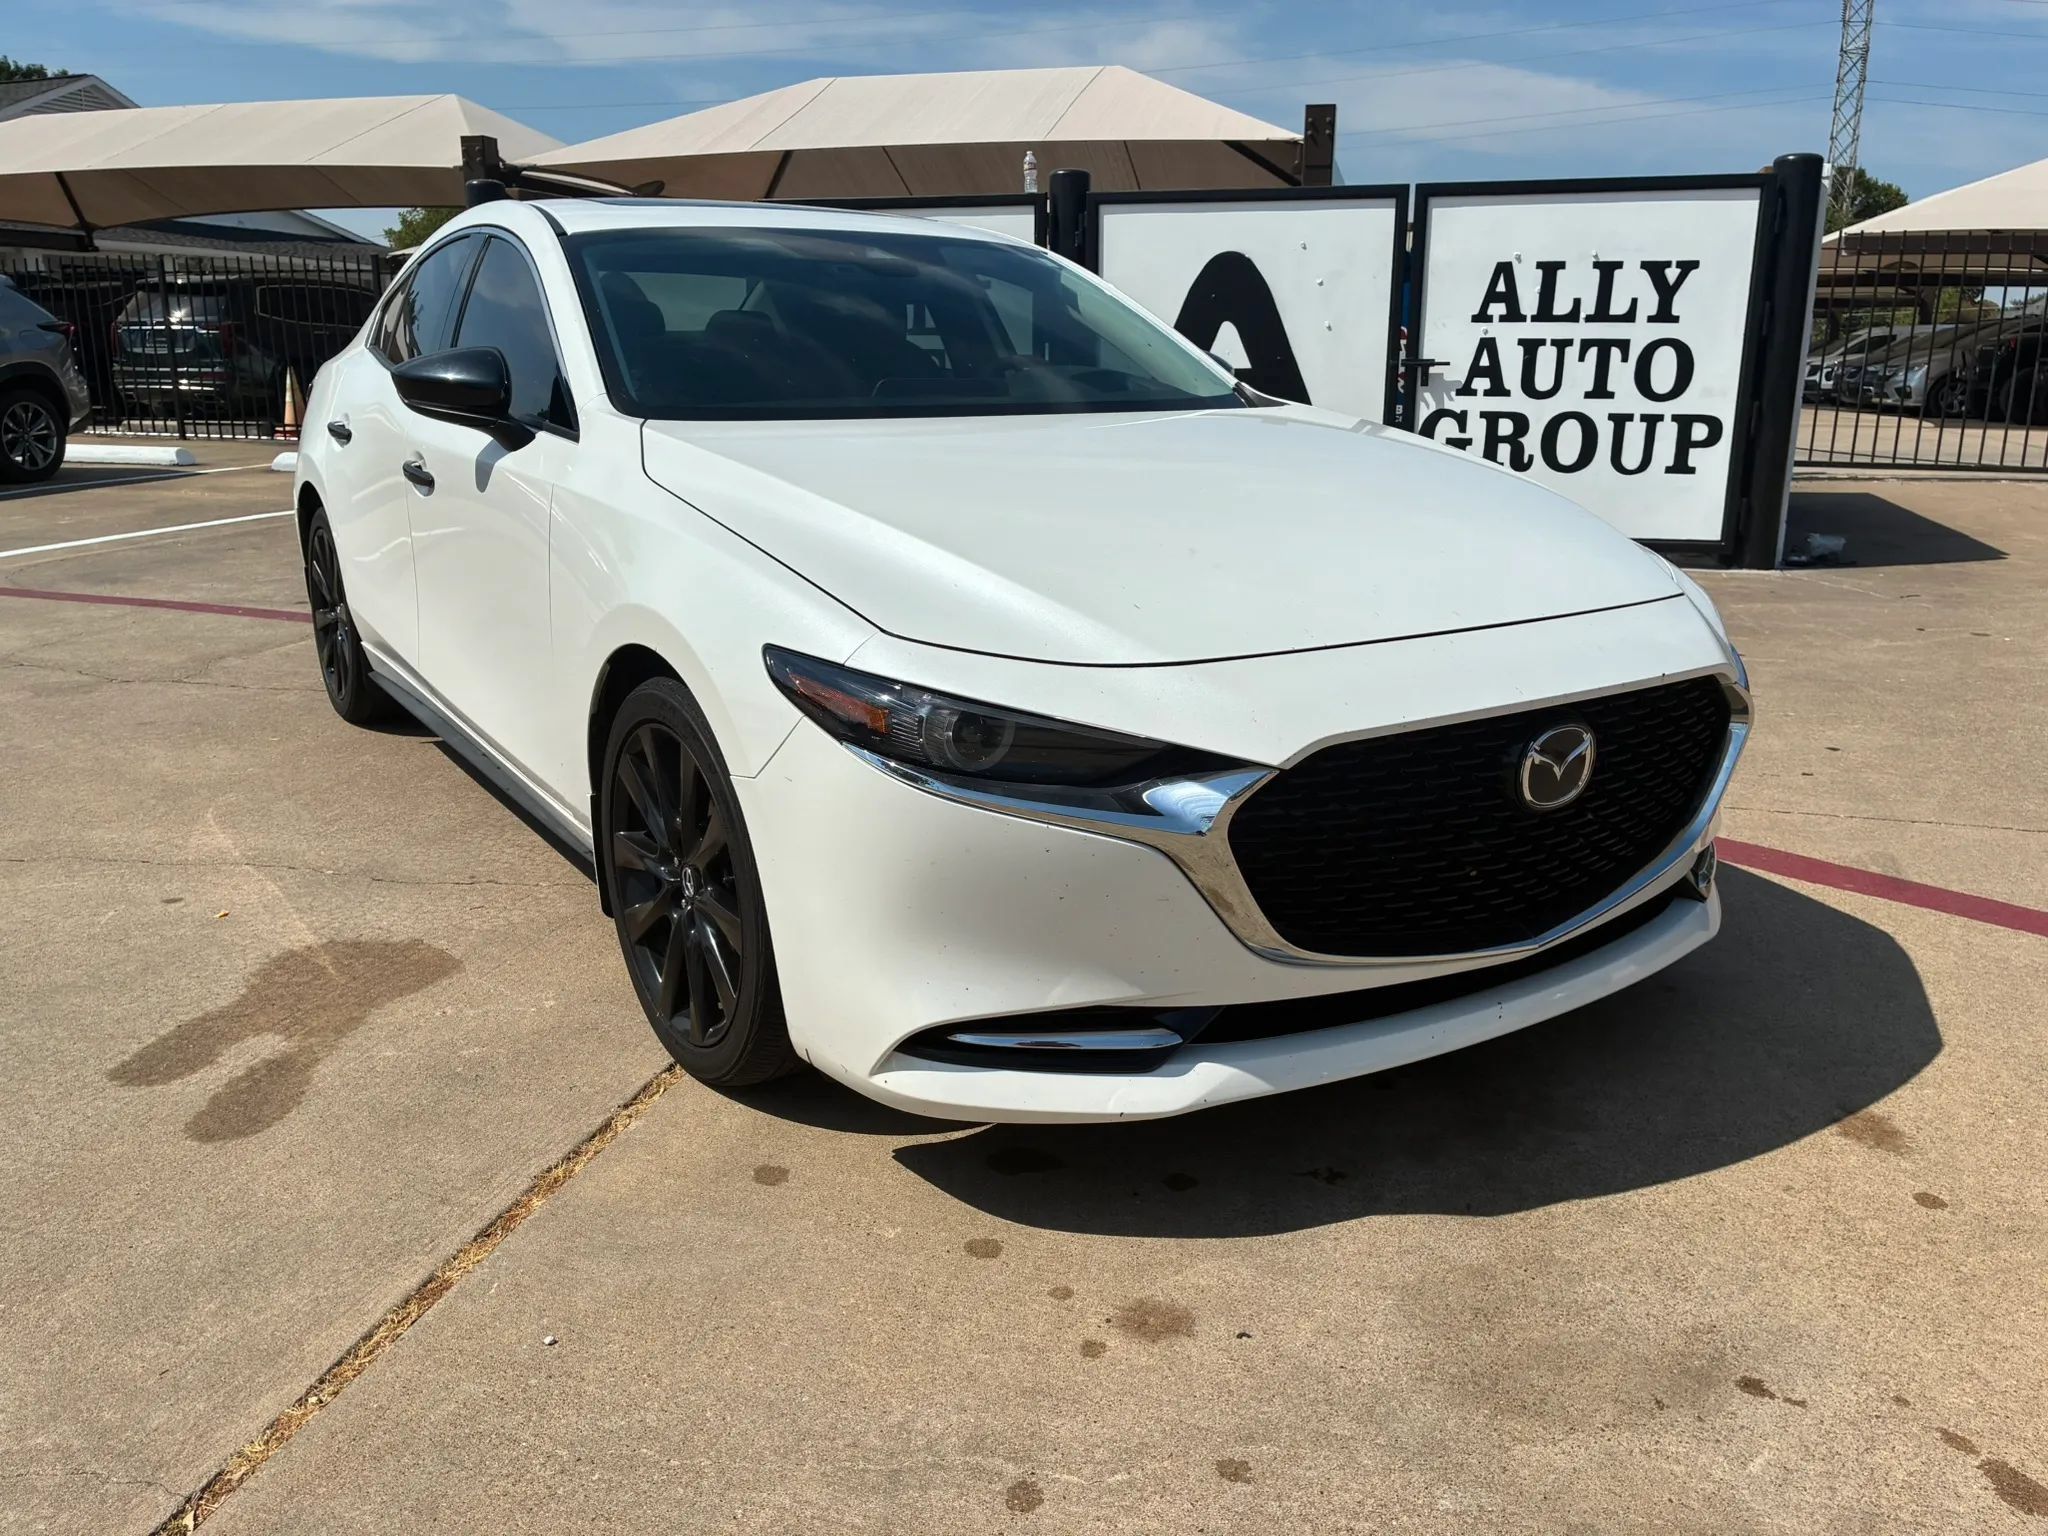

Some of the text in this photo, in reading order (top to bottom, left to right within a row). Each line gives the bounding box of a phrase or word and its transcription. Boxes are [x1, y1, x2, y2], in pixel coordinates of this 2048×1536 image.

[1471, 260, 1700, 323] ALLY
[1455, 337, 1695, 402] AUTO
[1418, 408, 1723, 475] GROUP
